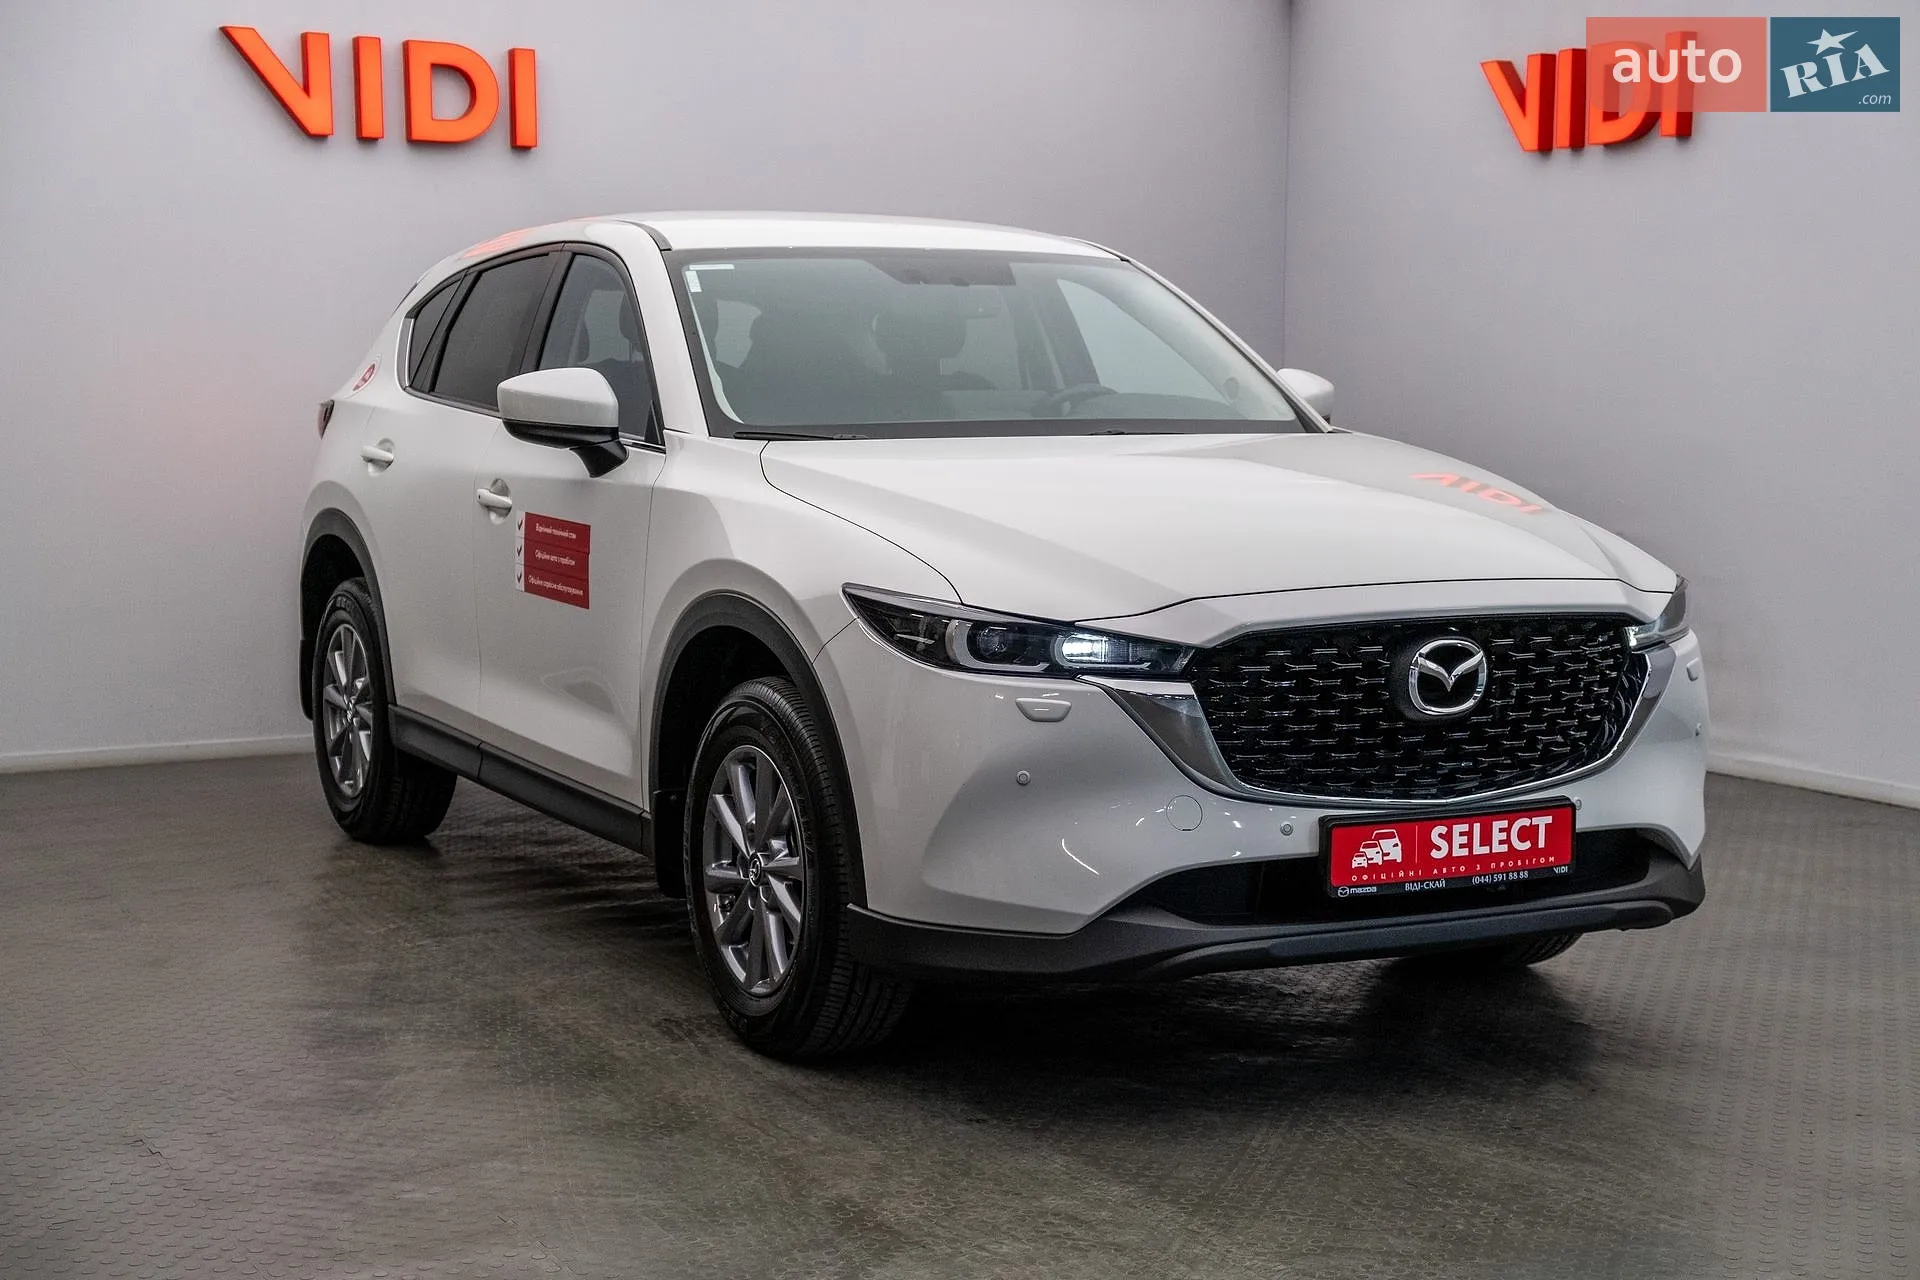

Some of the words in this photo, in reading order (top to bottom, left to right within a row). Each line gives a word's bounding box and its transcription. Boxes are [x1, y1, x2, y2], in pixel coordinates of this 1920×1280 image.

[219, 25, 537, 149] VIDI
[1480, 31, 1697, 151] VIDI
[1430, 816, 1553, 859] SELECT
[1351, 870, 1423, 882] ОФІЦІЙНІ
[1433, 865, 1466, 875] АВТО
[1490, 856, 1556, 870] ПРОБІГОМ
[1405, 879, 1446, 892] ВІДІ-СКАЙ
[1472, 875, 1492, 886] (044)
[1493, 873, 1507, 883] 591
[1508, 872, 1518, 881] 88
[1519, 870, 1529, 880] 88
